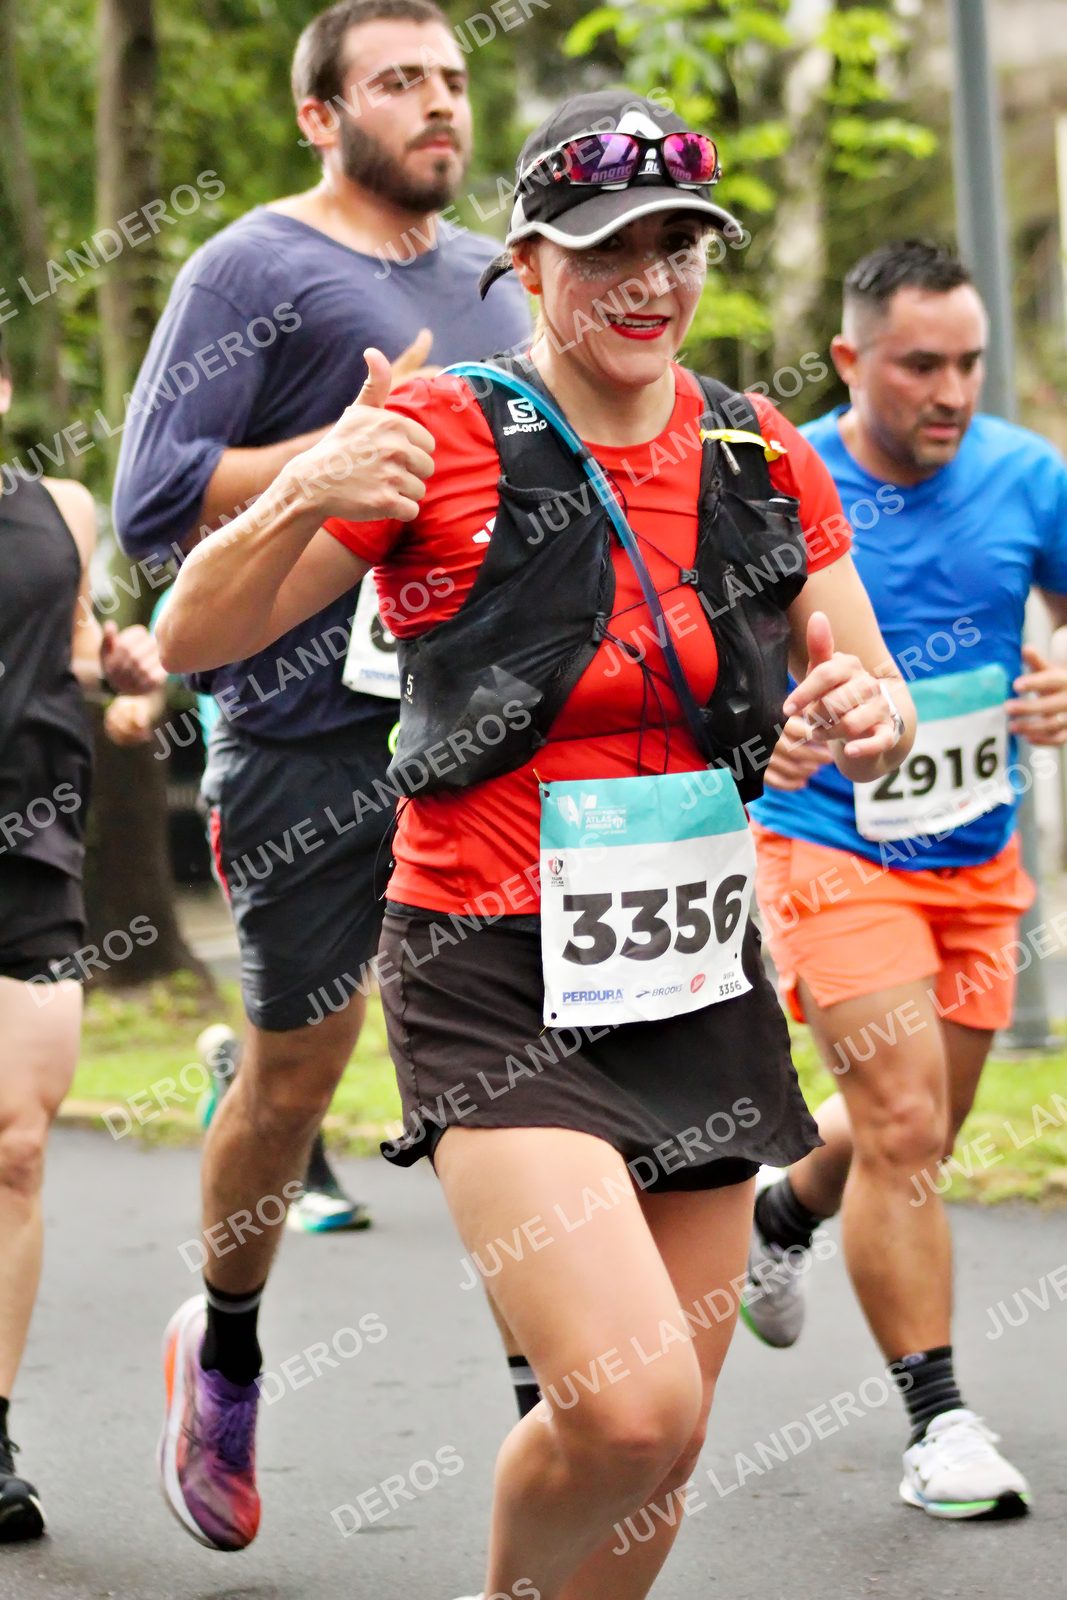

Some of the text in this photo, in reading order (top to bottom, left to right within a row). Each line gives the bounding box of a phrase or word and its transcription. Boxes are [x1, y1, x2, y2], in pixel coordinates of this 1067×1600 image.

[502, 419, 548, 436] salomo
[871, 736, 998, 802] 2916
[562, 874, 748, 966] 3356
[562, 988, 624, 1002] PERDURA
[718, 980, 742, 996] 3356
